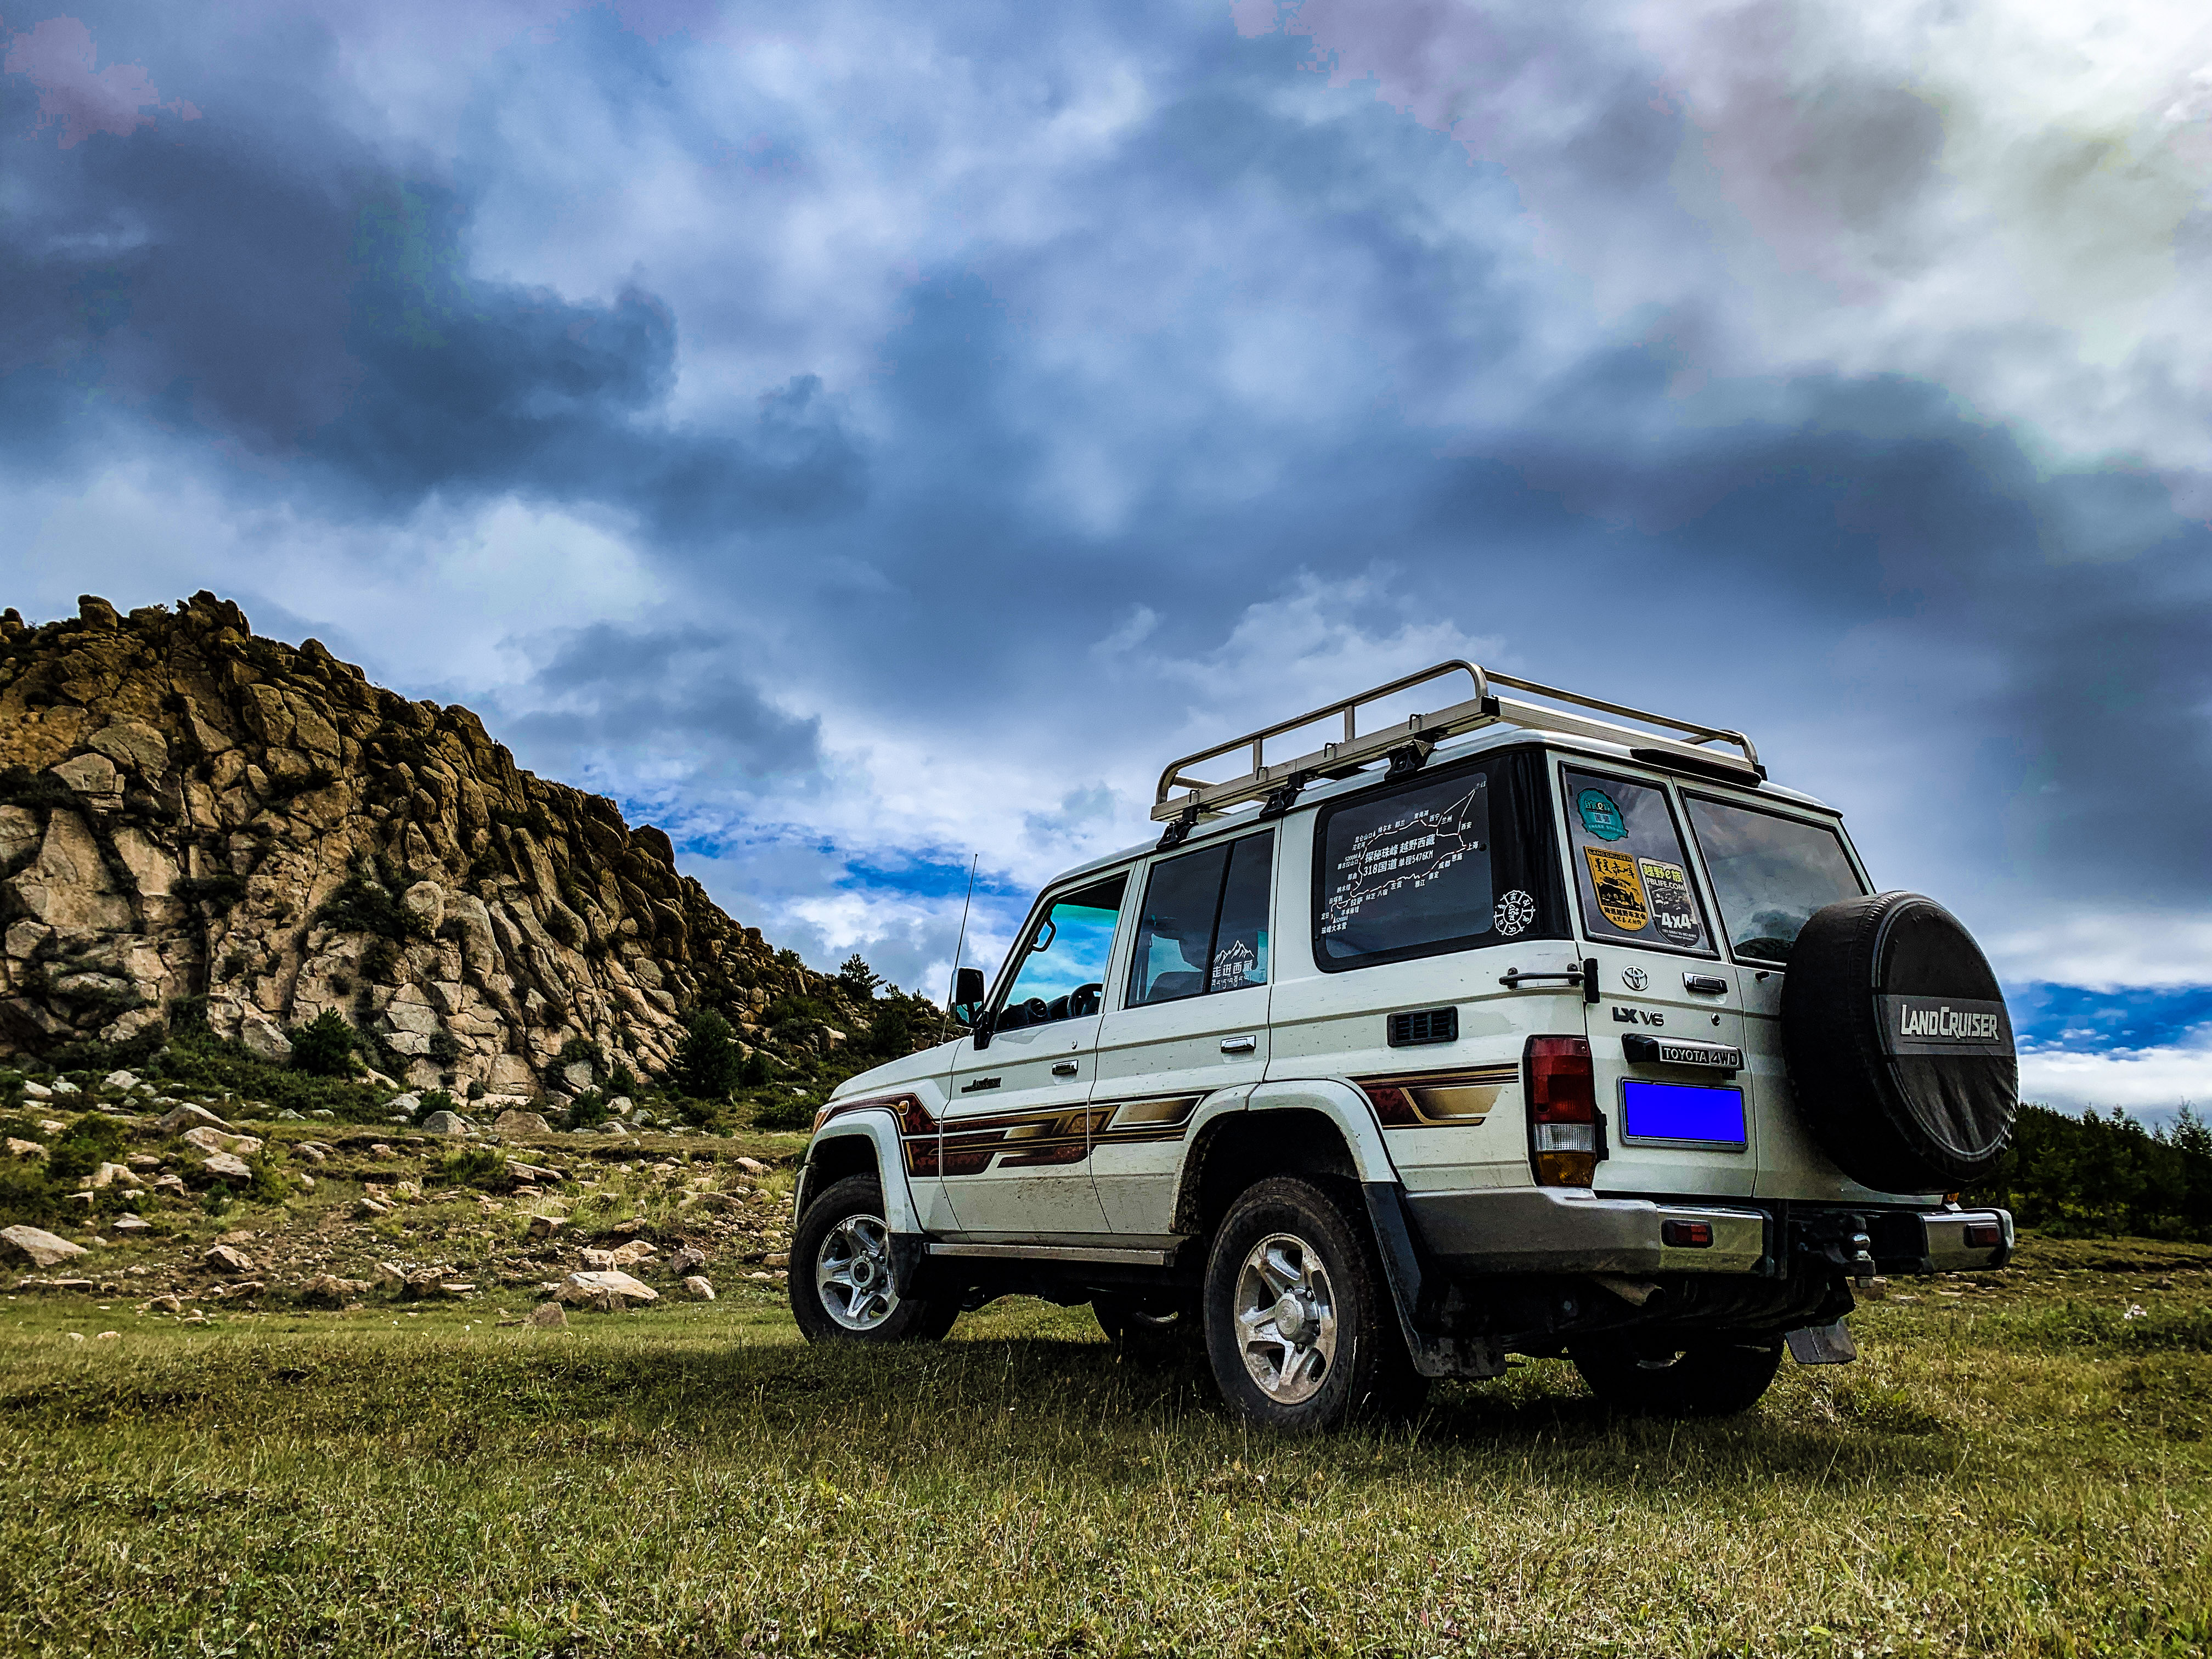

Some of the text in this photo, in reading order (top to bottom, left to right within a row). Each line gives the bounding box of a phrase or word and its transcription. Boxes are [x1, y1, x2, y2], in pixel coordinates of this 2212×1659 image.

[1414, 810, 1429, 820] 青海湖
[1429, 813, 1440, 822] 西宁
[1441, 815, 1453, 825] 兰州
[1378, 823, 1392, 833] 格尔木
[1461, 822, 1472, 831] 西安
[1355, 832, 1373, 843] 昆仑山口
[1364, 834, 1436, 864] 探秘珠峰 越野西藏
[1466, 841, 1479, 851] 上海
[1452, 853, 1463, 862] 恩施
[1606, 853, 1631, 861] CRUISER
[1338, 859, 1358, 870] 唐古拉山口
[1363, 850, 1434, 876] 318国道 单程5476KM
[1438, 860, 1451, 870] 成都
[1347, 872, 1357, 881] 那曲
[1429, 871, 1440, 880] 康定
[1643, 864, 1683, 883] 越野e族
[1337, 884, 1351, 893] 纳木错
[1391, 881, 1403, 890] 左贡
[1415, 879, 1425, 888] 雅江
[1646, 877, 1686, 891] FBLIFE.COM
[1377, 889, 1388, 897] 八宿
[1329, 895, 1343, 904] 日喀则
[1351, 897, 1363, 906] 拉萨
[1321, 922, 1347, 934] 珠峰大本营
[1212, 959, 1253, 978] 走进西藏
[1612, 1006, 1664, 1026] LX V6
[1664, 1048, 1739, 1066] TOYOTA 4WD
